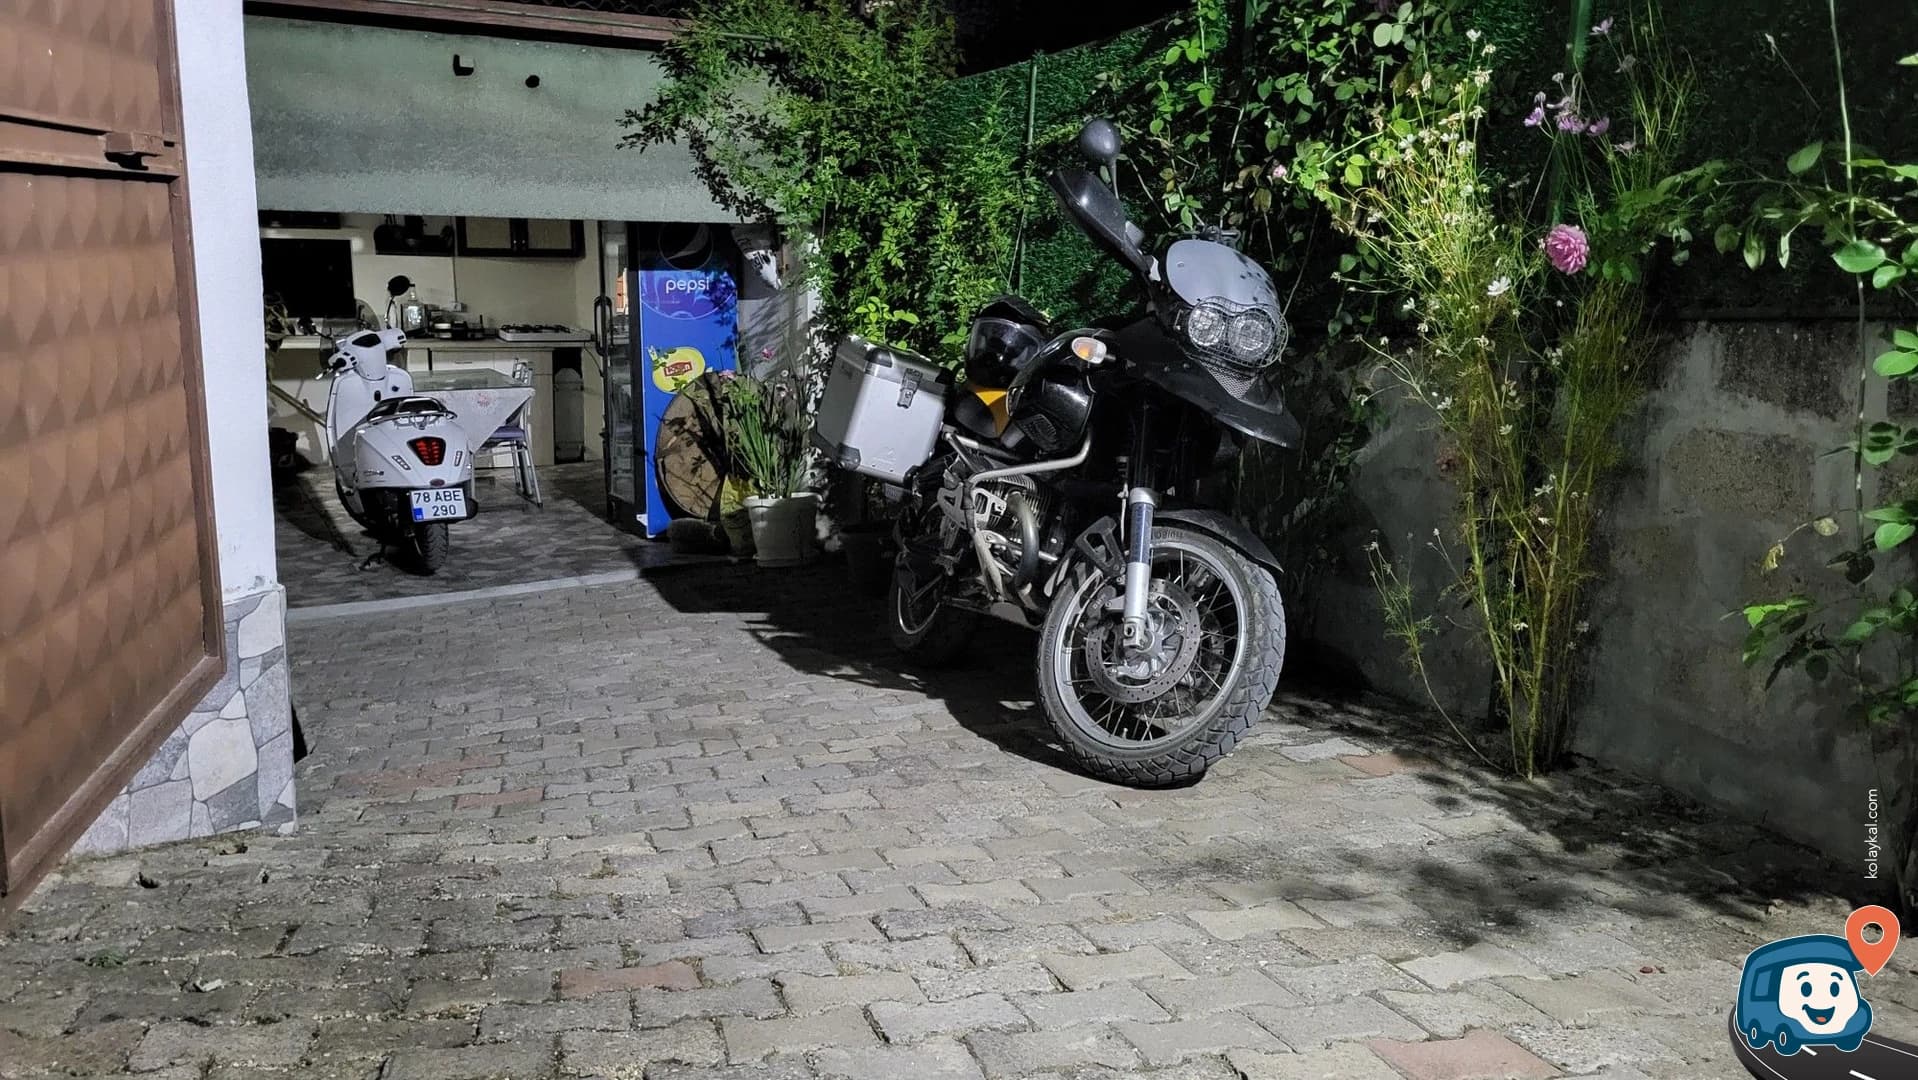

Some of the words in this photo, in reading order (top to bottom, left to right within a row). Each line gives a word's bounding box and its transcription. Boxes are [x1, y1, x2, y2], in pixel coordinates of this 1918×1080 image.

[666, 277, 710, 294] pepsi
[414, 492, 431, 504] 78
[435, 490, 462, 502] ABE
[432, 504, 457, 516] 290
